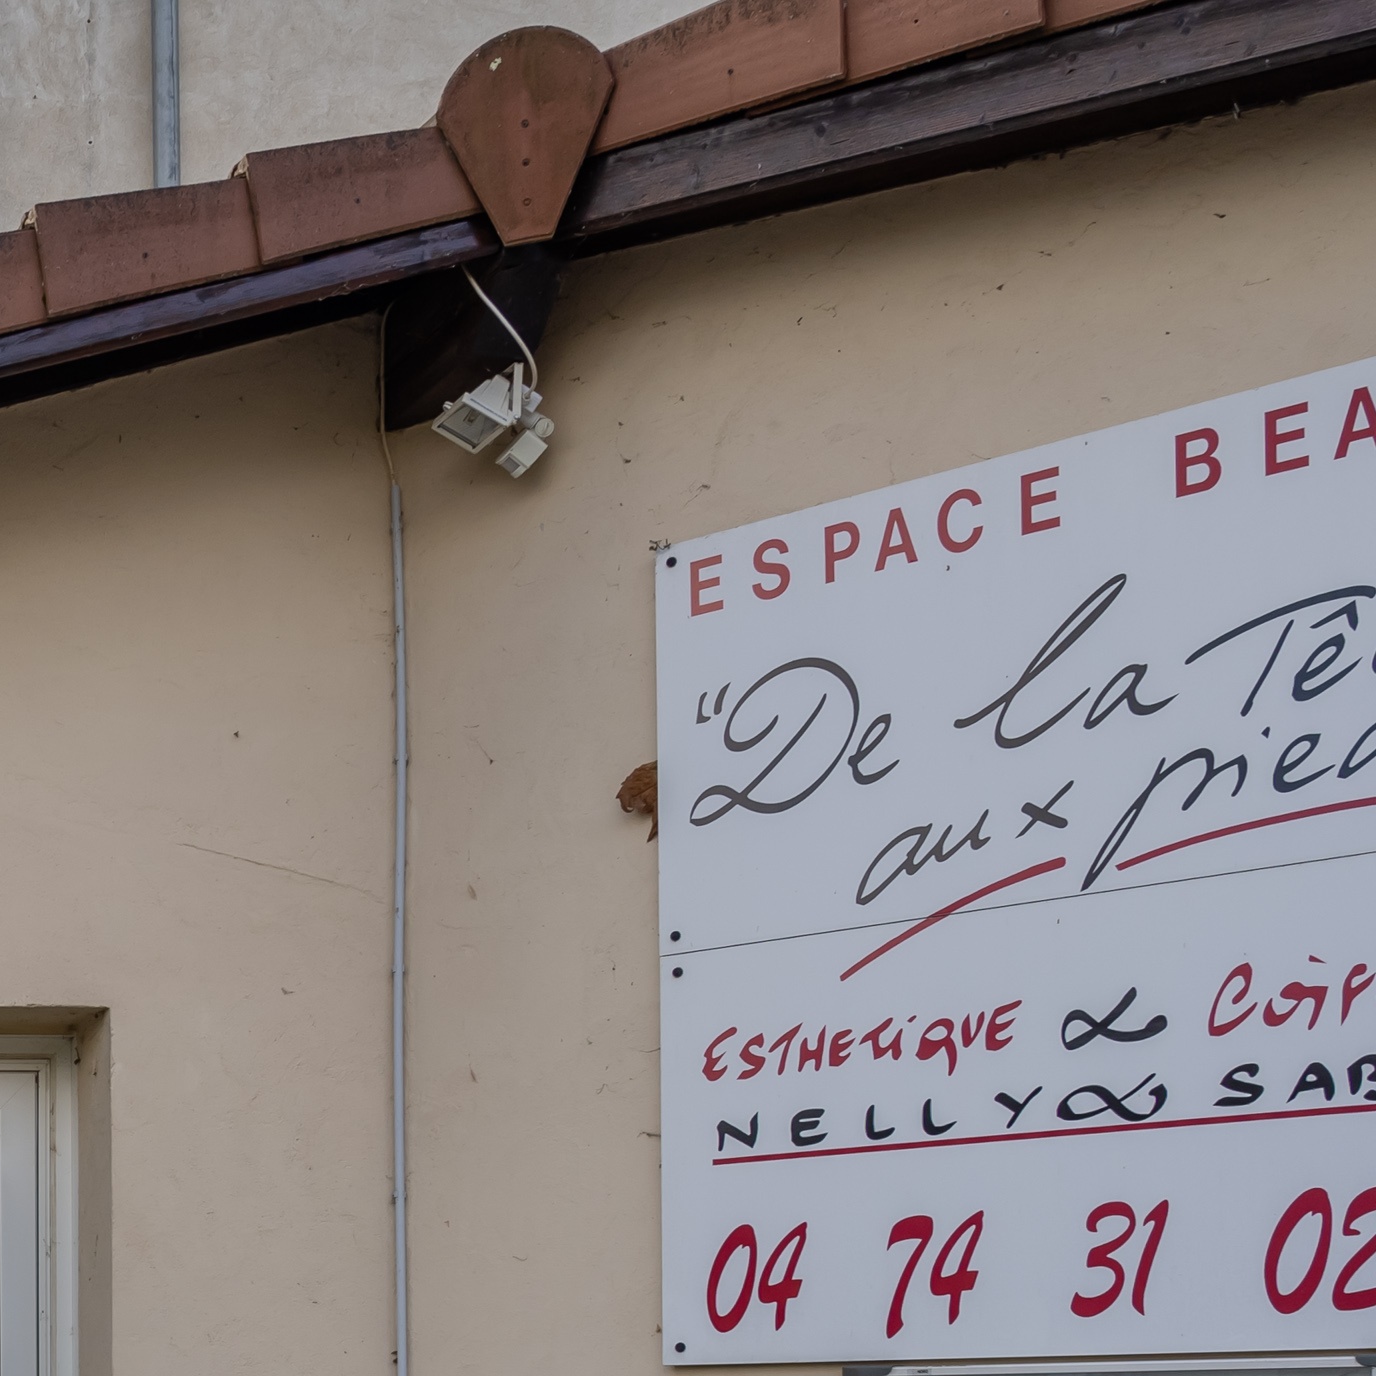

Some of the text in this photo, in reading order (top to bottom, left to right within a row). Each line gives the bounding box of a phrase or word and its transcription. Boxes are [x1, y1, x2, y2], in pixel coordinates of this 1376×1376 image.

[689, 465, 1062, 617] ESPACE
[953, 573, 1179, 750] la
[1184, 584, 1376, 718] Tê
[855, 780, 1075, 907] aux
[716, 1086, 1044, 1152] NELLY
[706, 1186, 1376, 1339] 04 74 31 02
